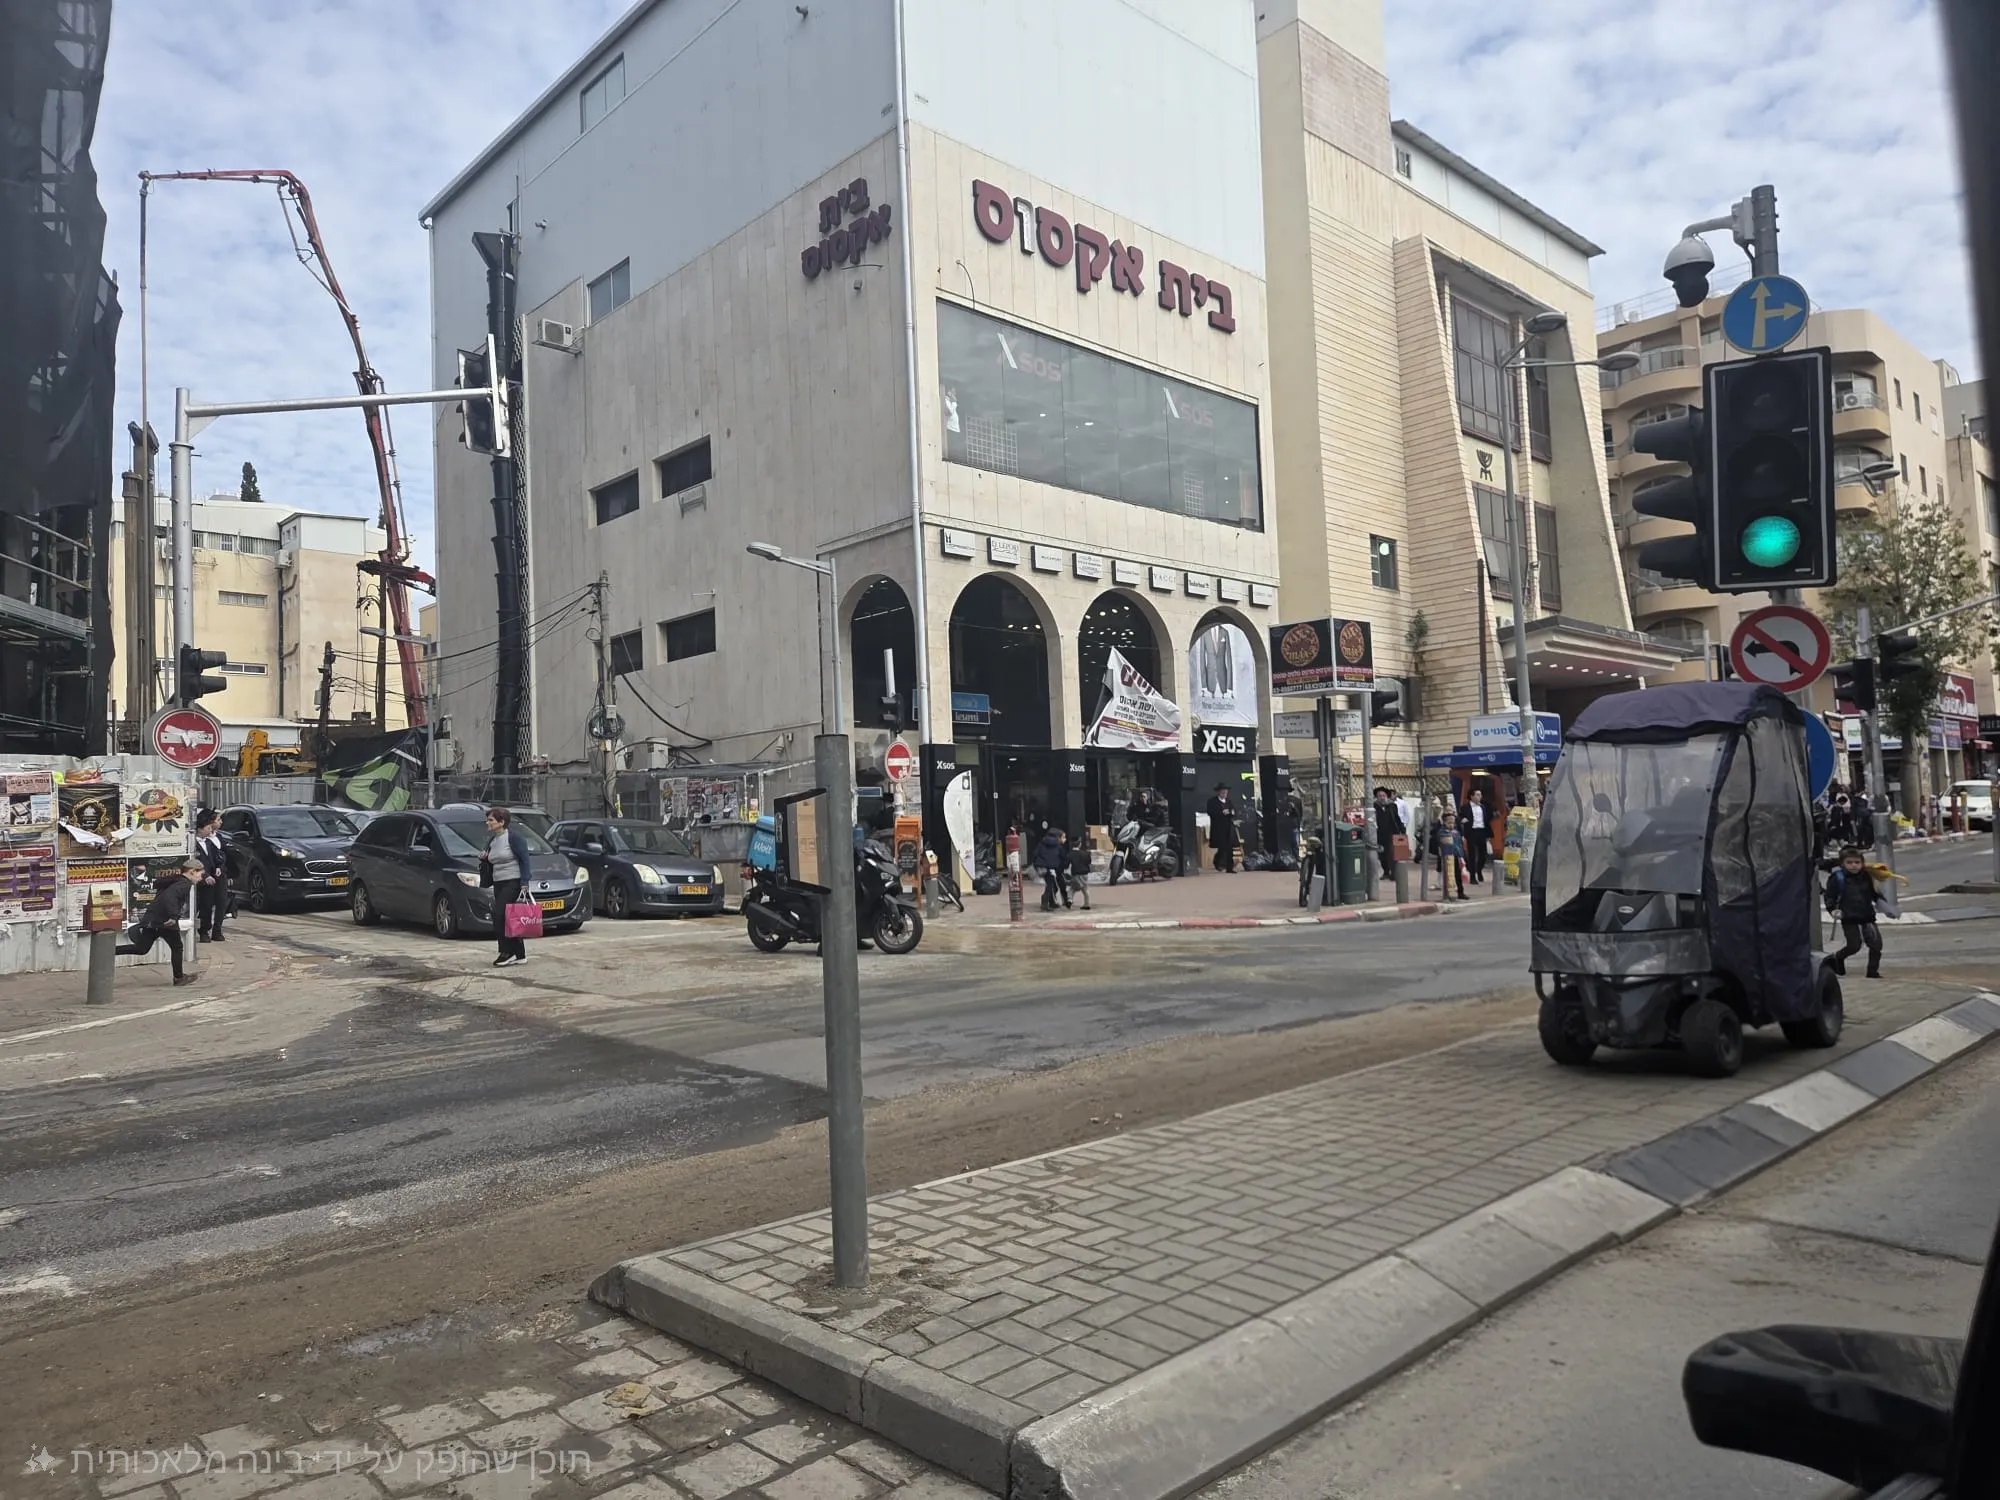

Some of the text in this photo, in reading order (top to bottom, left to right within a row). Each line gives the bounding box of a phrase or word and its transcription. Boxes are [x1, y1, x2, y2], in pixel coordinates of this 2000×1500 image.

[818, 177, 871, 234] בית
[800, 203, 892, 280] אקסוס
[972, 178, 1237, 334] בית אקסוס
[1202, 729, 1246, 754] Xsos
[936, 760, 956, 770] Xsos
[1069, 763, 1086, 773] Xsos
